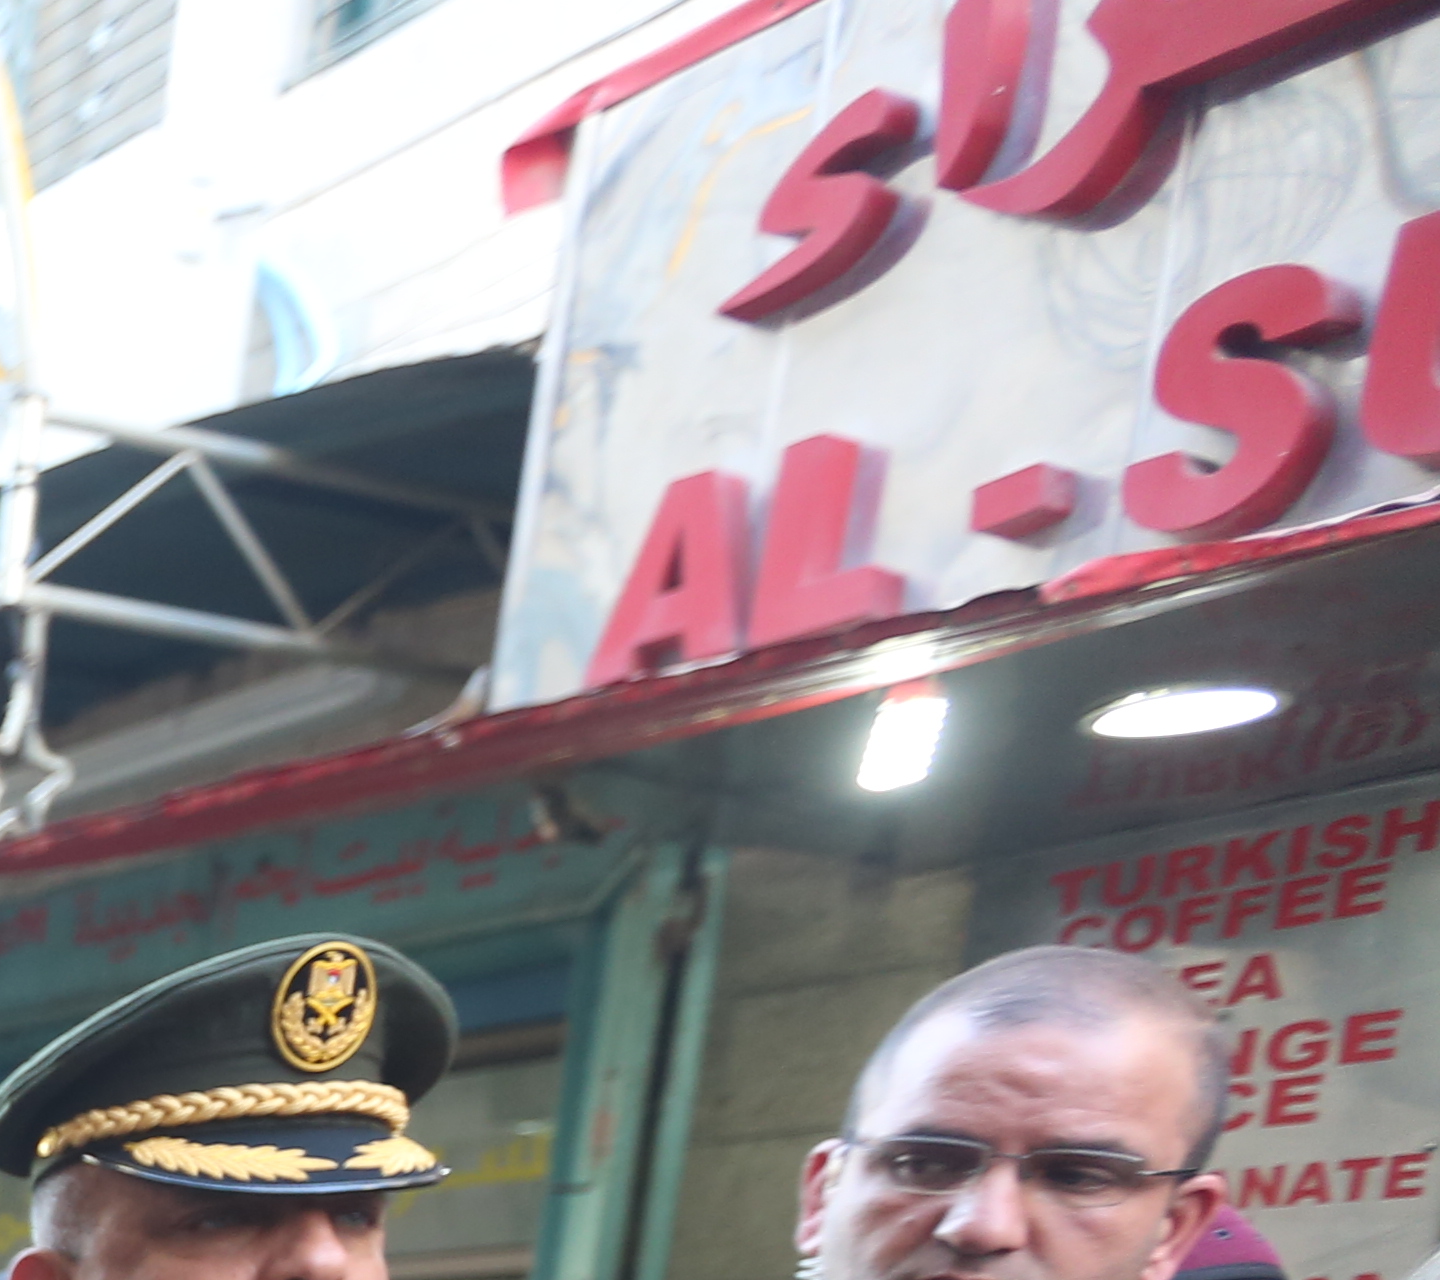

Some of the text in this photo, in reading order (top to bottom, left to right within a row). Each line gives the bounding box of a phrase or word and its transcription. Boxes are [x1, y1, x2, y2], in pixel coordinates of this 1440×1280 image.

[1049, 800, 1440, 917] TURKISH
[1056, 862, 1393, 954] COFFEE
[1177, 952, 1285, 1006] EA
